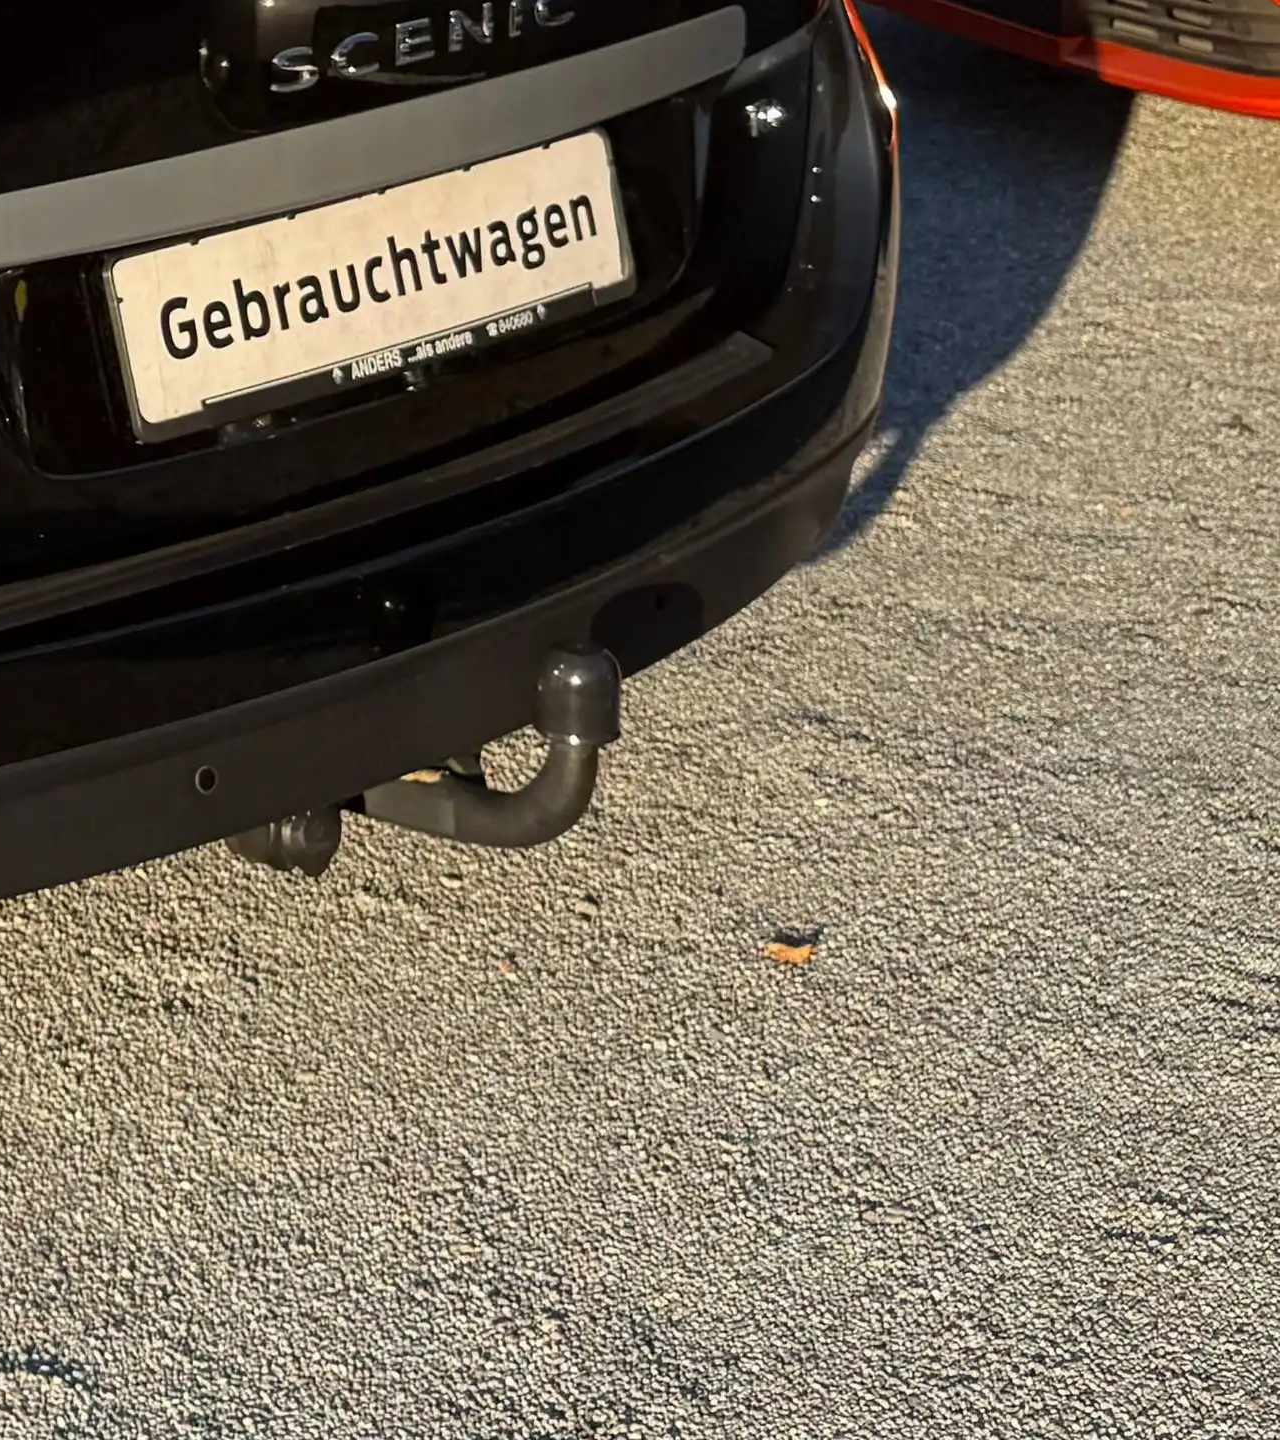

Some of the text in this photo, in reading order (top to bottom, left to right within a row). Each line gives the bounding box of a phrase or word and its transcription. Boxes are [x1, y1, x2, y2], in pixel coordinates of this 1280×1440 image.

[159, 193, 598, 360] Gebrauchtwagen
[351, 349, 403, 380] ANDERS
[435, 330, 473, 355] andere
